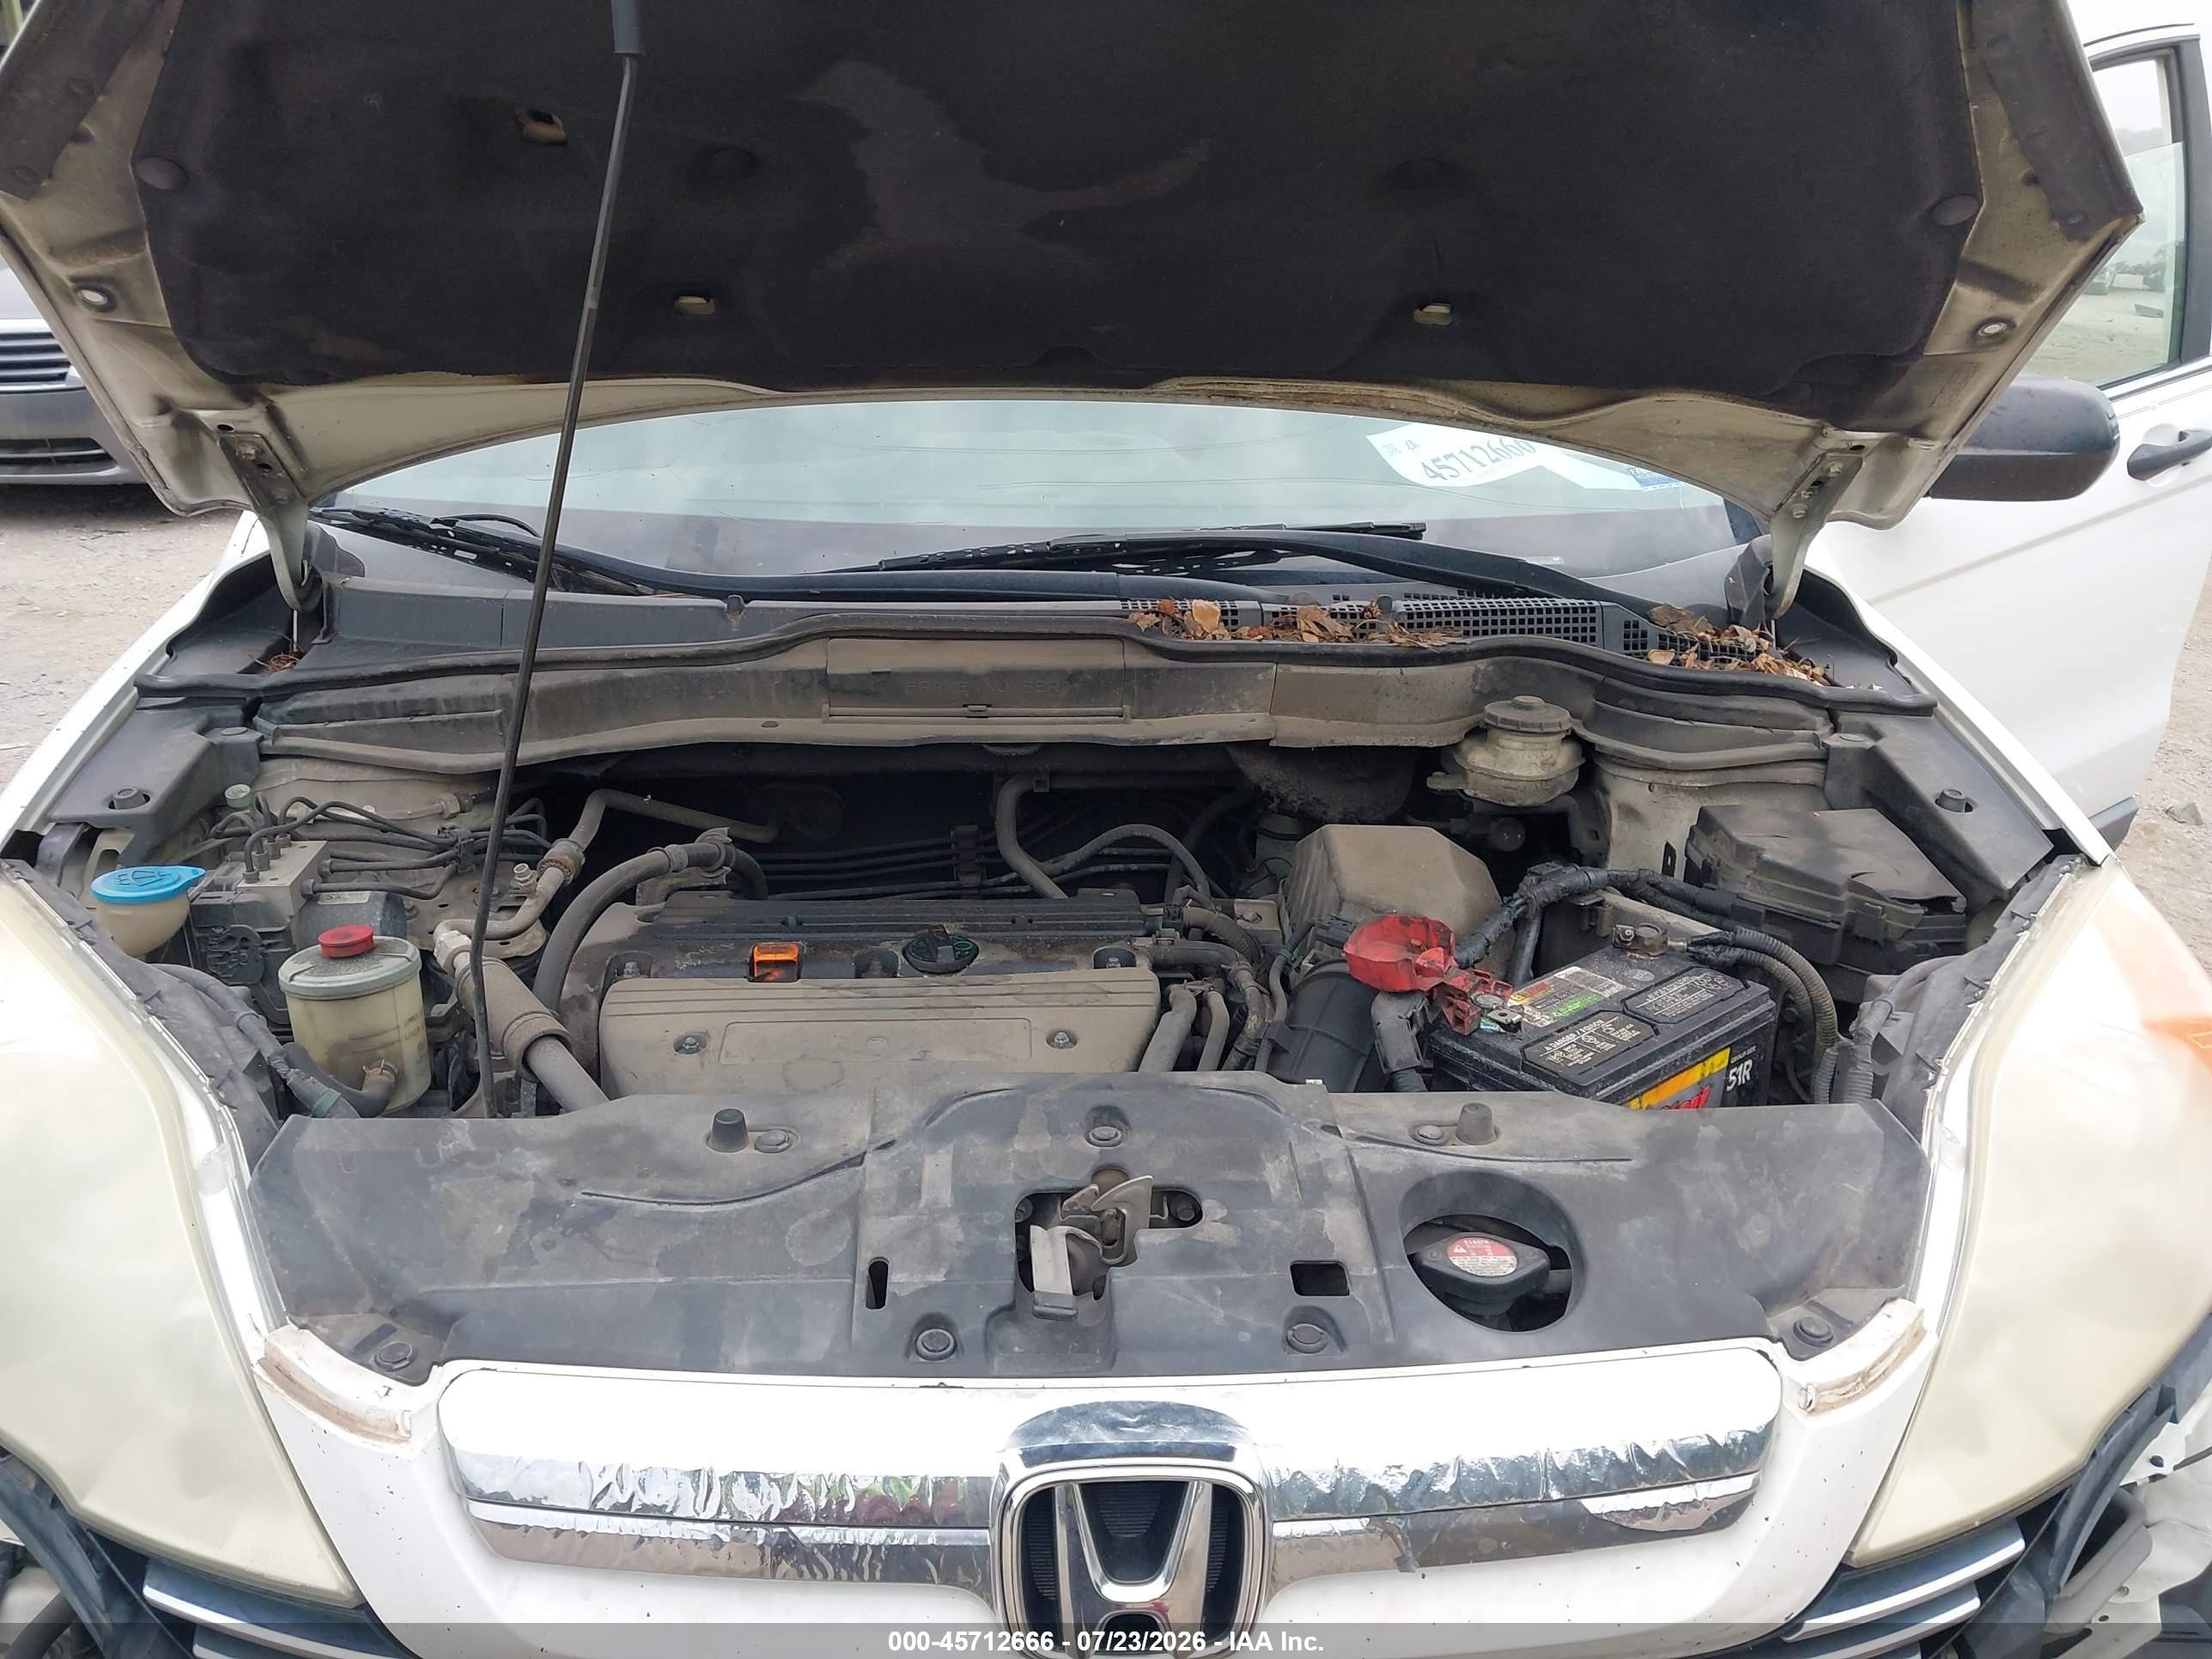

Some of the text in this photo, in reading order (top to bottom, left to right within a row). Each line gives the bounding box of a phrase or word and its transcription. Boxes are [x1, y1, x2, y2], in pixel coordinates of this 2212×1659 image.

[1420, 436, 1537, 481] 45712666
[906, 678, 1060, 694] FRAME NUMBER
[1548, 1032, 1577, 1048] DANGER
[1726, 1059, 1753, 1092] 51R
